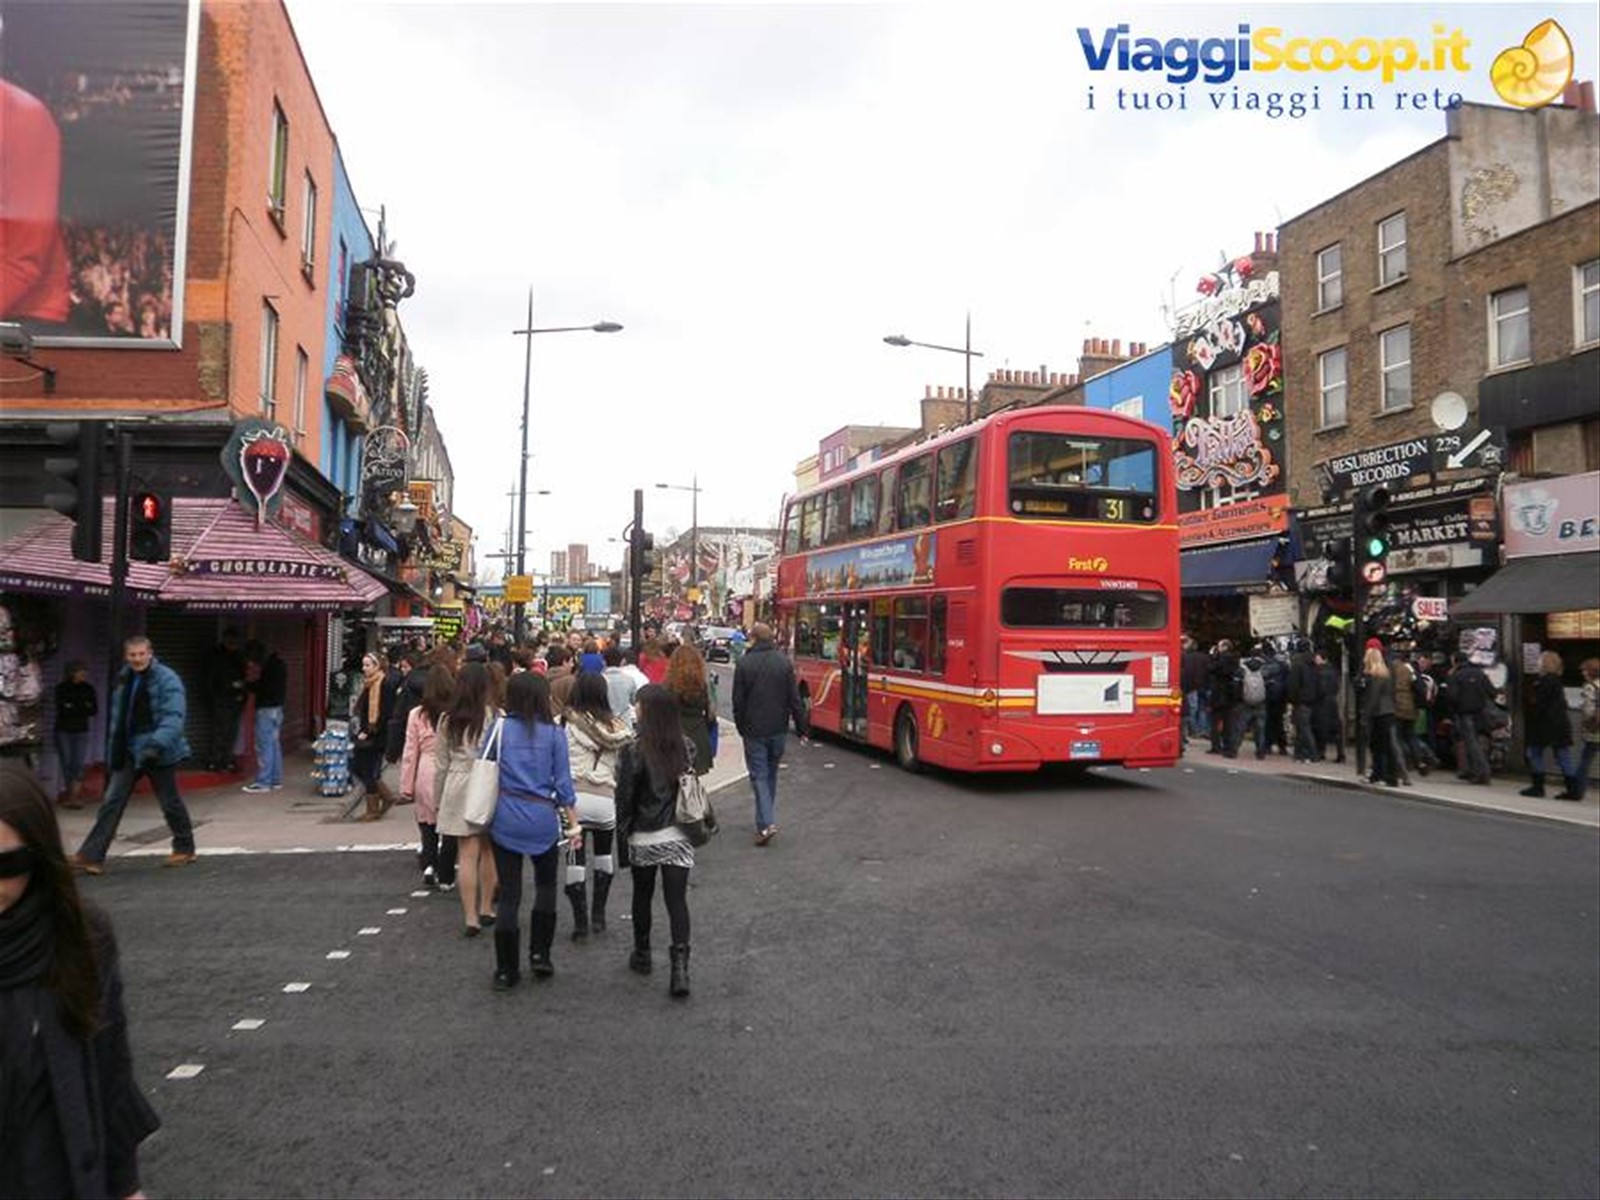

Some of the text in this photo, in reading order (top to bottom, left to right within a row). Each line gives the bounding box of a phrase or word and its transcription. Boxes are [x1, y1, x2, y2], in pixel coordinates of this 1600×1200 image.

[1331, 439, 1429, 475] RESURRECTION
[1351, 461, 1411, 487] RECORDS
[1106, 499, 1124, 519] 31
[1397, 523, 1468, 545] MARKET
[1068, 557, 1093, 570] First
